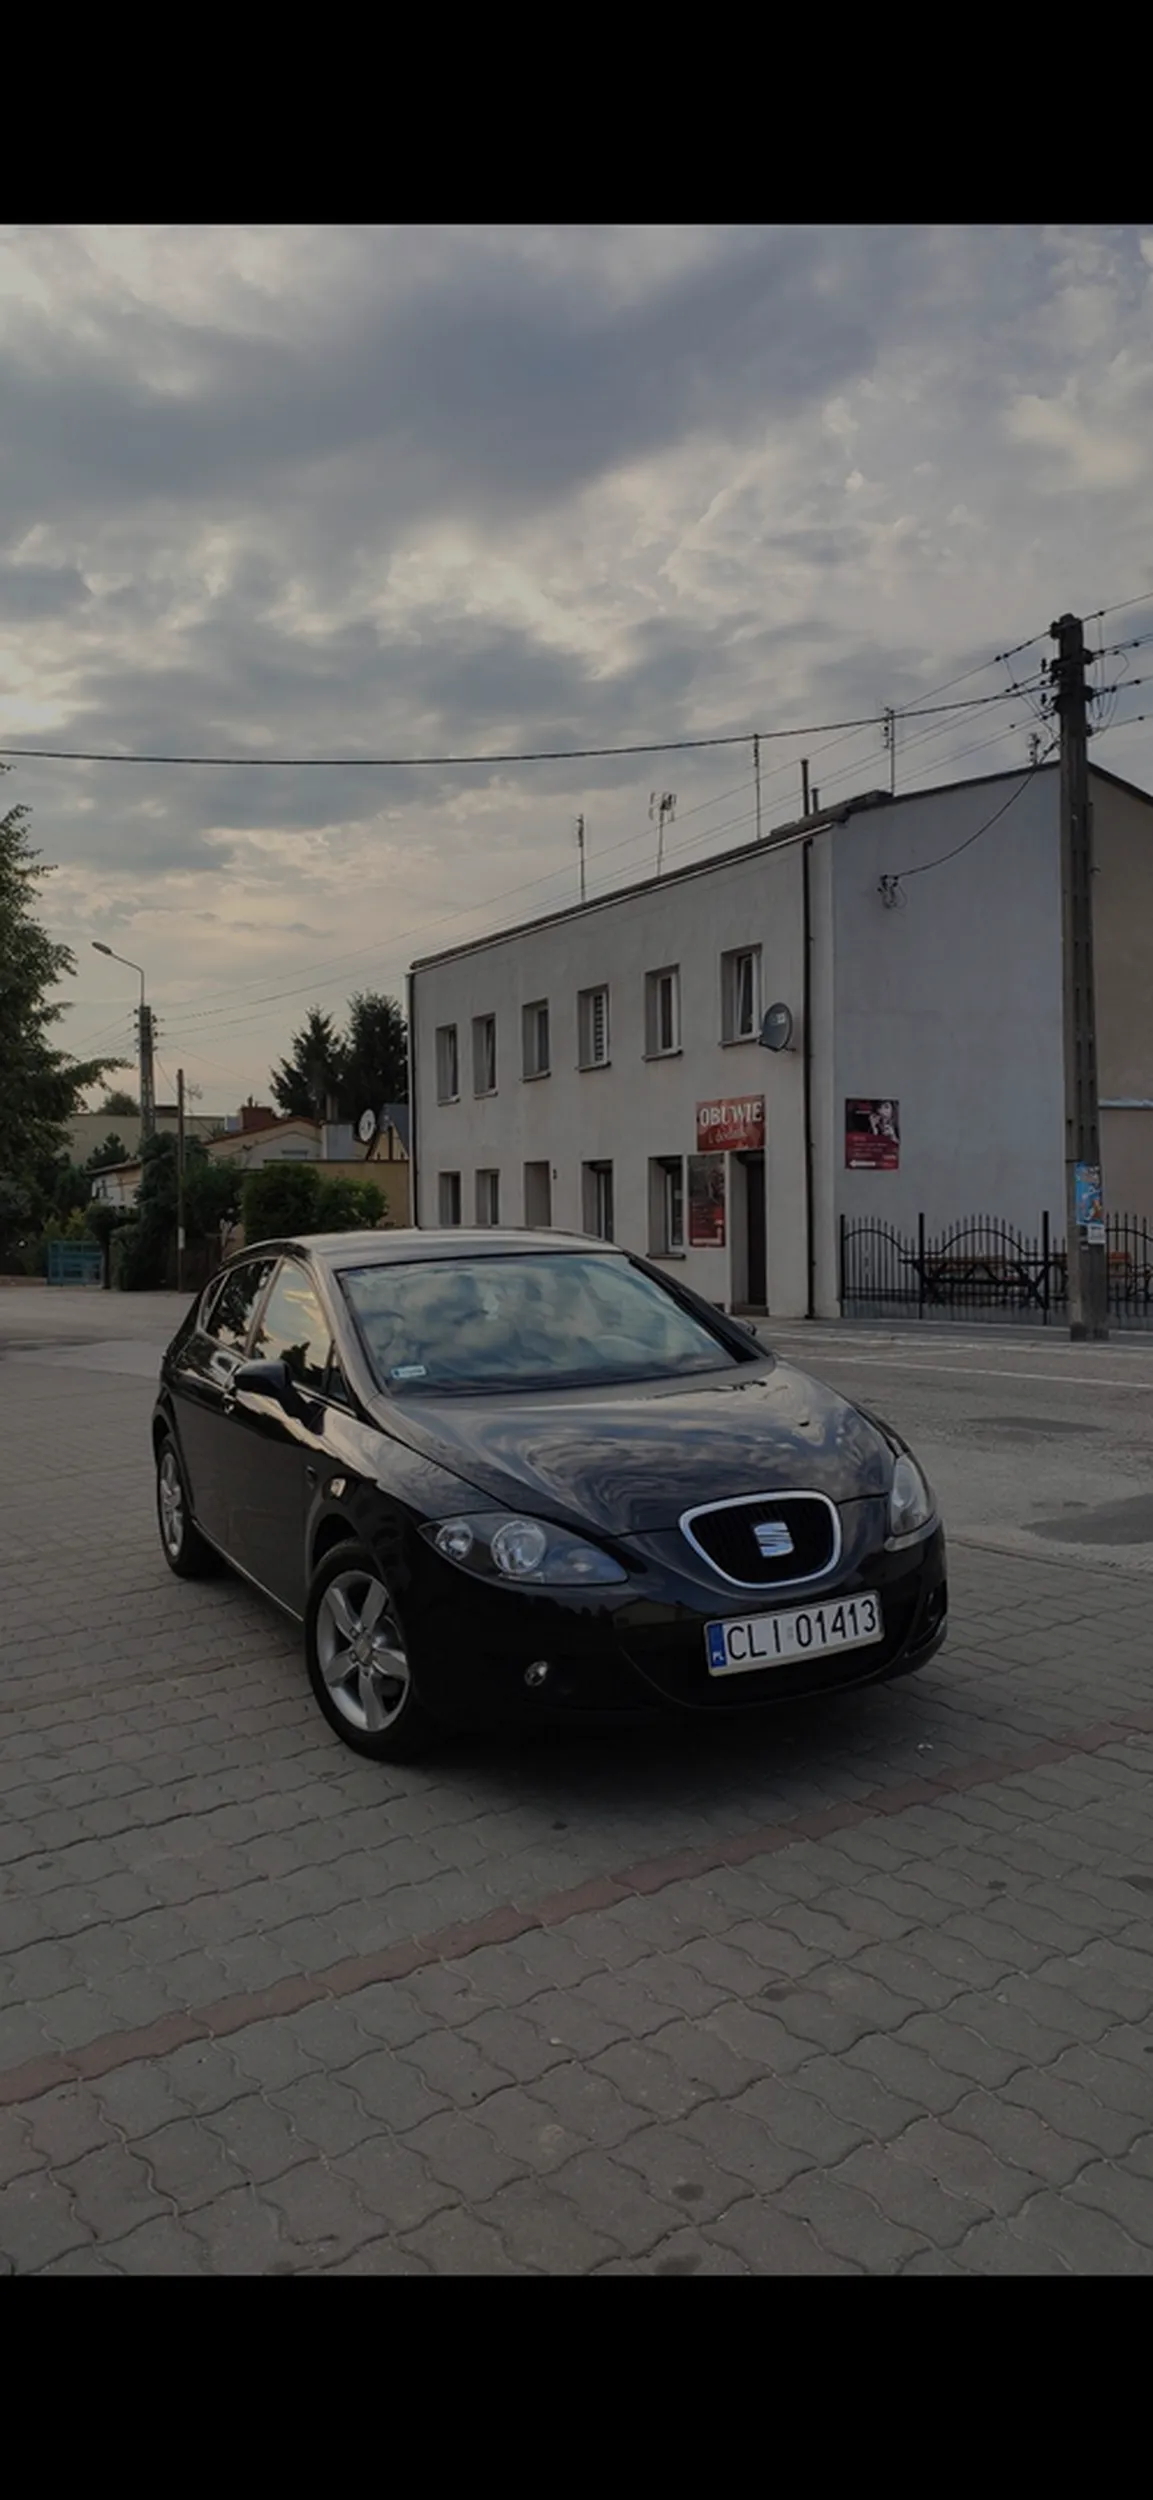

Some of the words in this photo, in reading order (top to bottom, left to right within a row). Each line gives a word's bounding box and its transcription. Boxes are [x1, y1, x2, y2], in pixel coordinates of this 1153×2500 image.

[700, 1101, 762, 1127] OBUWIE
[727, 1619, 781, 1660] CLI
[796, 1600, 876, 1647] 01413
